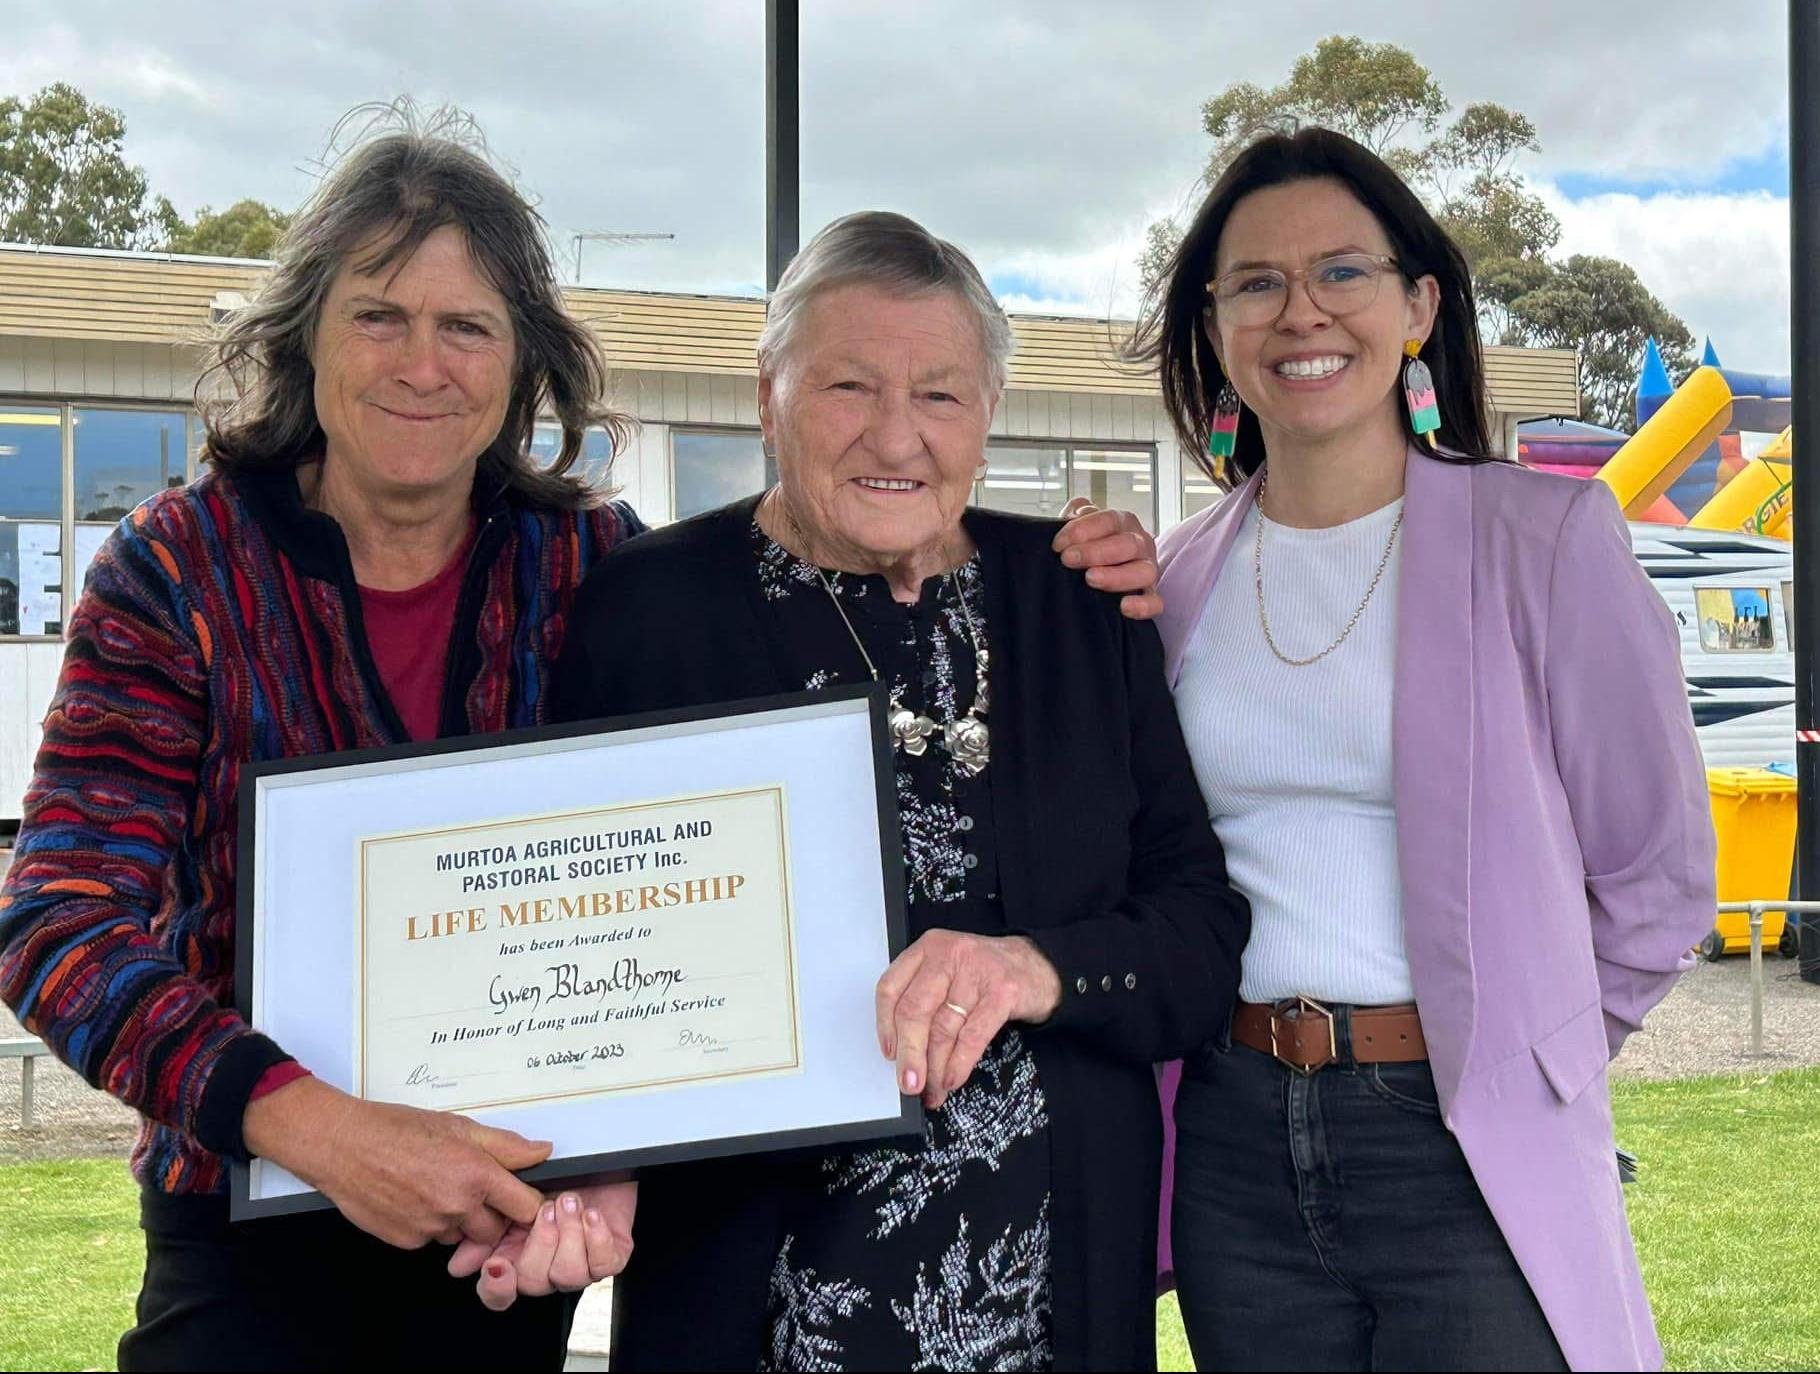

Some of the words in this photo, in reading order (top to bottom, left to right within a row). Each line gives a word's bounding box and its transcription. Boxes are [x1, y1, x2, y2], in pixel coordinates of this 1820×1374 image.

[436, 846, 517, 871] MURTOA
[523, 826, 666, 861] AGRICULTURAL
[674, 820, 712, 841] AND
[463, 859, 560, 892] PASTORAL
[568, 852, 647, 879] SOCIETY
[655, 850, 687, 868] Inc.
[407, 907, 487, 940] LIFE
[499, 874, 745, 928] MEMBERSHIP
[500, 942, 525, 956] has
[529, 938, 564, 952] been
[568, 929, 633, 948] Awarded
[637, 926, 651, 938] to
[489, 974, 541, 1015] Gwen
[430, 1031, 447, 1044] In
[453, 1023, 502, 1041] Honor
[506, 1019, 525, 1037] of
[527, 1015, 565, 1032] Long
[571, 1011, 598, 1026] and
[604, 1001, 666, 1023] Faithful
[670, 996, 725, 1013] Service
[591, 1043, 625, 1060] 2023
